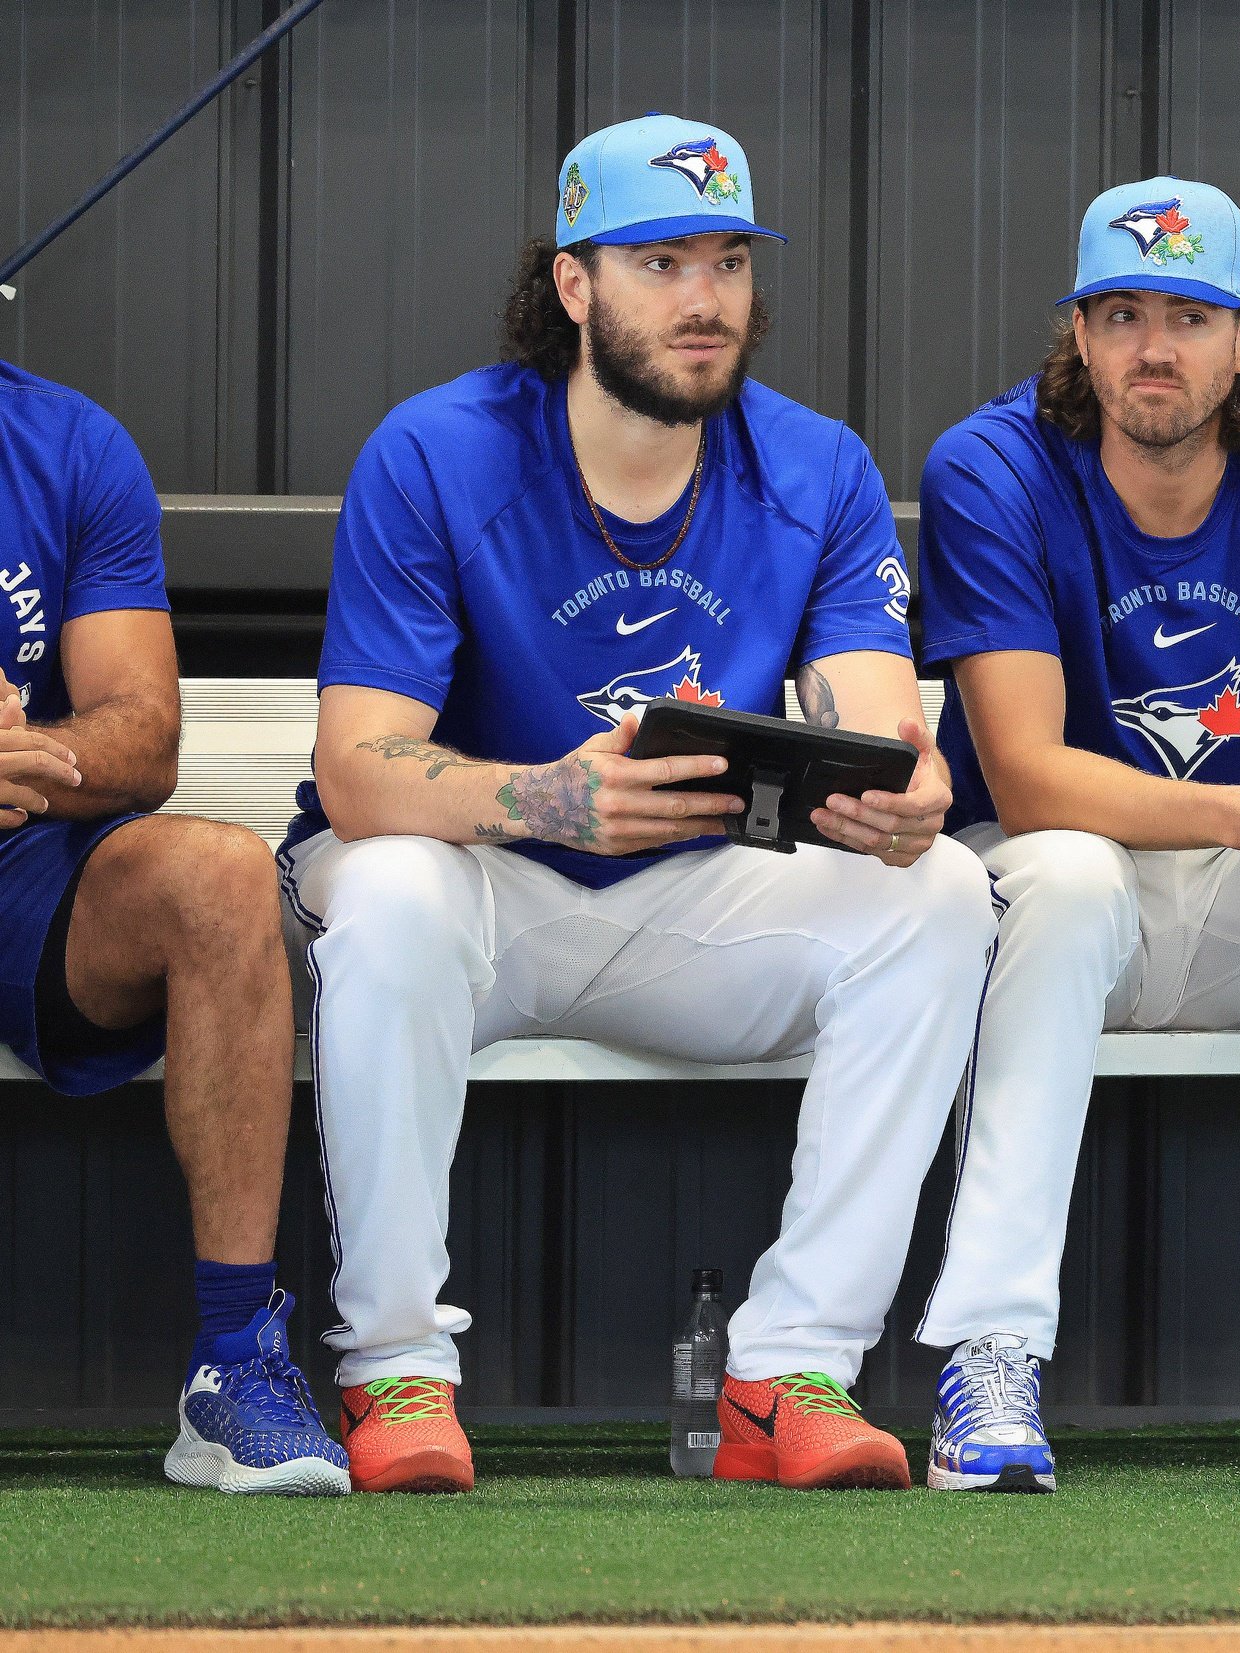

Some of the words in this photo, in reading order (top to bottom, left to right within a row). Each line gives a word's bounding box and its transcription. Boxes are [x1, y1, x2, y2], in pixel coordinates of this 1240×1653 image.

[0, 561, 46, 663] JAYS
[551, 570, 631, 626] TORONTO
[639, 568, 731, 626] BASEBALL
